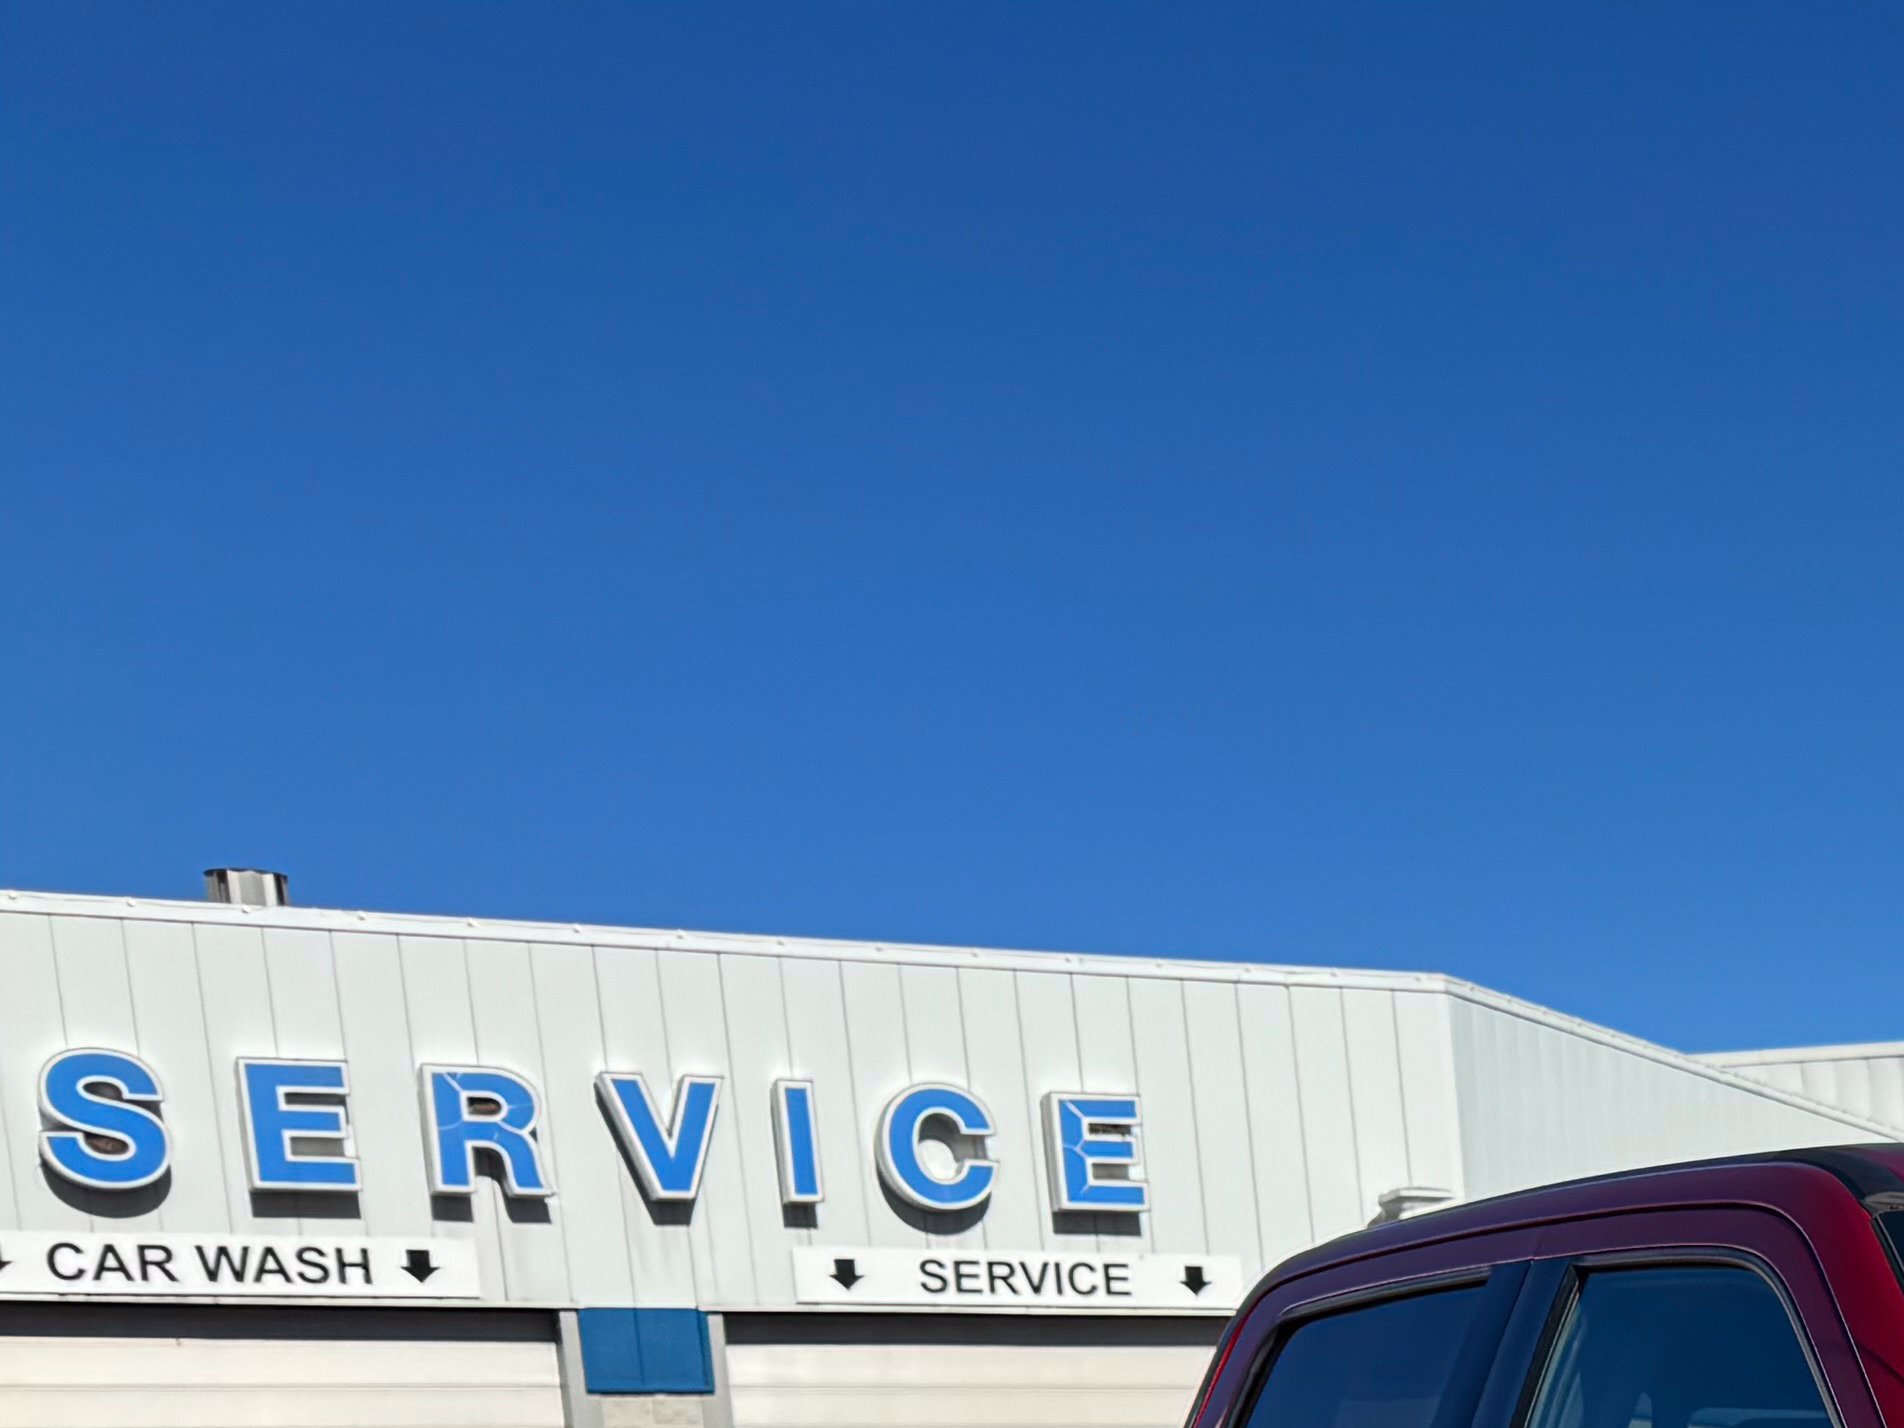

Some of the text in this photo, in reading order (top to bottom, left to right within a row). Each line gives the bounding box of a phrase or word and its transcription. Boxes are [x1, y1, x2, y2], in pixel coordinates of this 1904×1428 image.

[37, 1047, 1149, 1213] SERVICE
[46, 1242, 374, 1285] CAR WASH
[919, 1258, 1133, 1296] SERVICE
